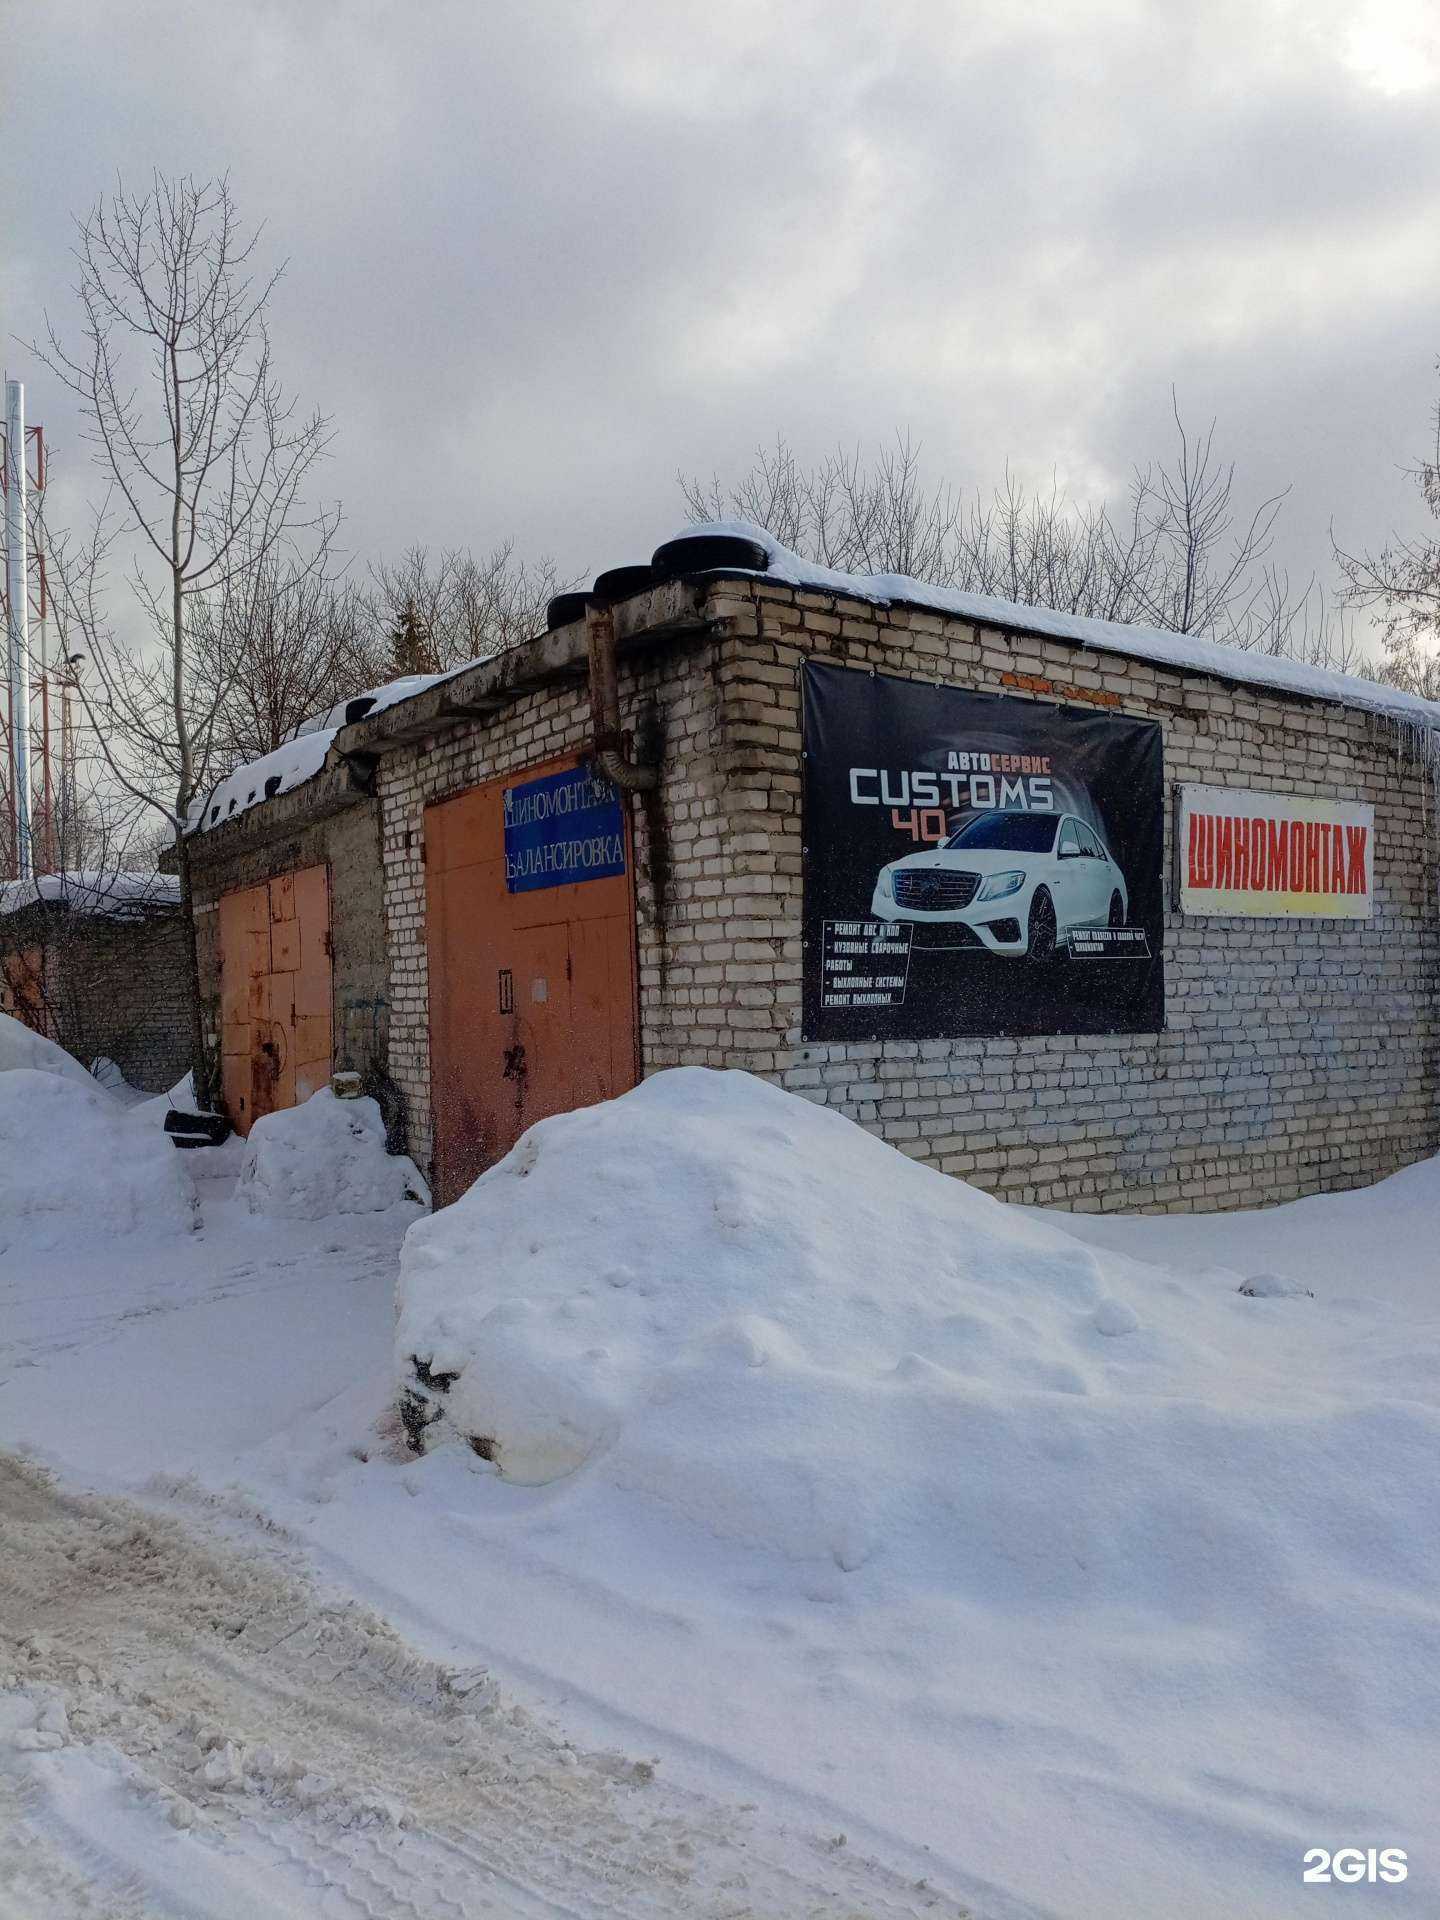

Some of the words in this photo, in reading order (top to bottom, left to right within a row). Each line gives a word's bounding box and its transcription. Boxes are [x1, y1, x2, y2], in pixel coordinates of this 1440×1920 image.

[948, 751, 1051, 774] АВТОСЕРВИС
[849, 767, 1054, 810] CUSTOMS
[891, 808, 947, 841] 40
[505, 833, 624, 878] БАЛАНСИРОВКА
[1188, 813, 1367, 894] ШИНОМОНТАЖ
[835, 923, 860, 935] РЕМОНТ
[834, 942, 868, 953] КУЗОВНЫЕ
[871, 943, 909, 954] СВАРОЧНЫЕ
[826, 960, 852, 970] РАБОТЫ
[833, 977, 873, 988] ВЫХЛОПНЫЕ
[875, 977, 904, 987] СИСТЕМЫ
[825, 995, 850, 1005] РЕМОНТ
[853, 993, 892, 1004] ВЫХЛОПНЫХ
